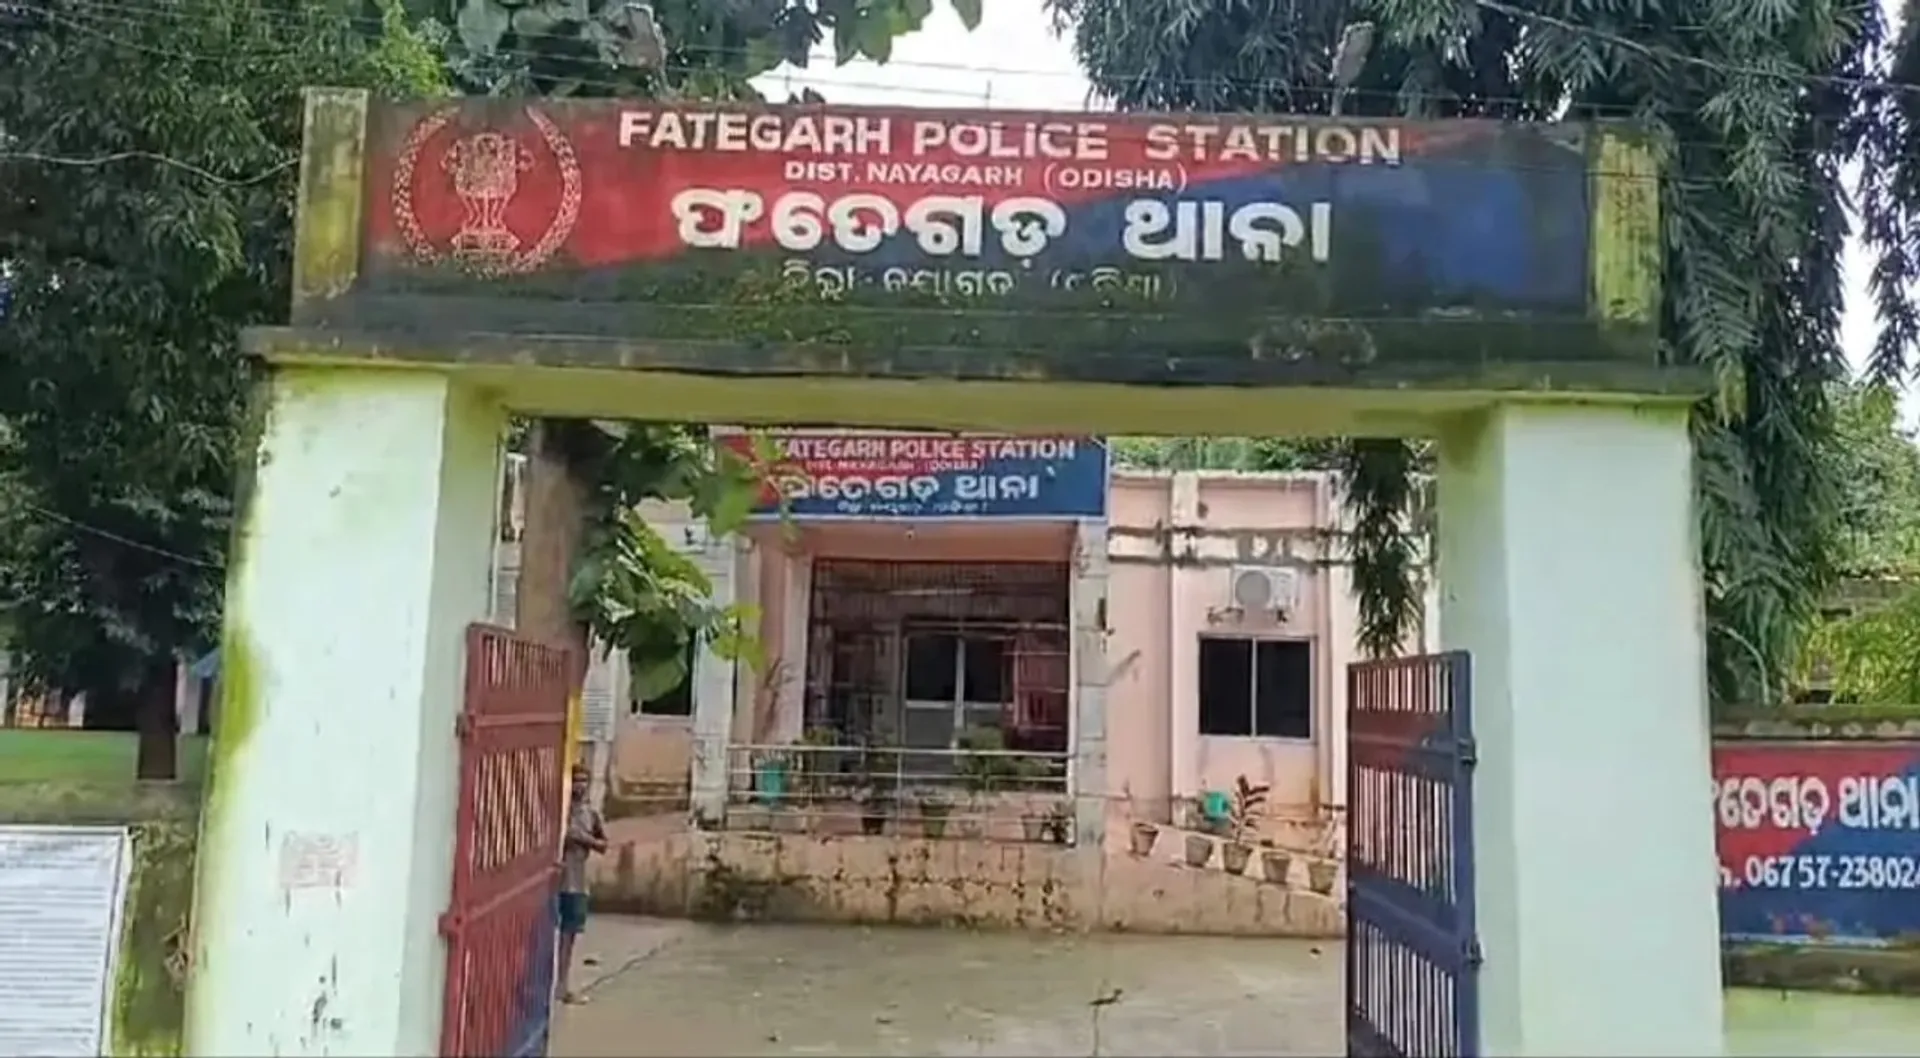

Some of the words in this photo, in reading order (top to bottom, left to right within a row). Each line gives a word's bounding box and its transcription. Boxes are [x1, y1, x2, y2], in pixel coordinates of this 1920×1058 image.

[619, 111, 891, 154] FATEGARH
[913, 121, 1109, 160] POLICE
[1145, 124, 1400, 165] STATION
[784, 161, 860, 182] DIST.
[867, 162, 1023, 186] NAYAGARH
[1044, 163, 1187, 197] (ODISHA)
[1123, 199, 1332, 261] ଥାନା
[890, 439, 964, 459] POLICE
[971, 440, 1076, 460] STATION
[954, 474, 1040, 500] ଥାନା
[1712, 776, 1830, 835] ତେଗଡ଼
